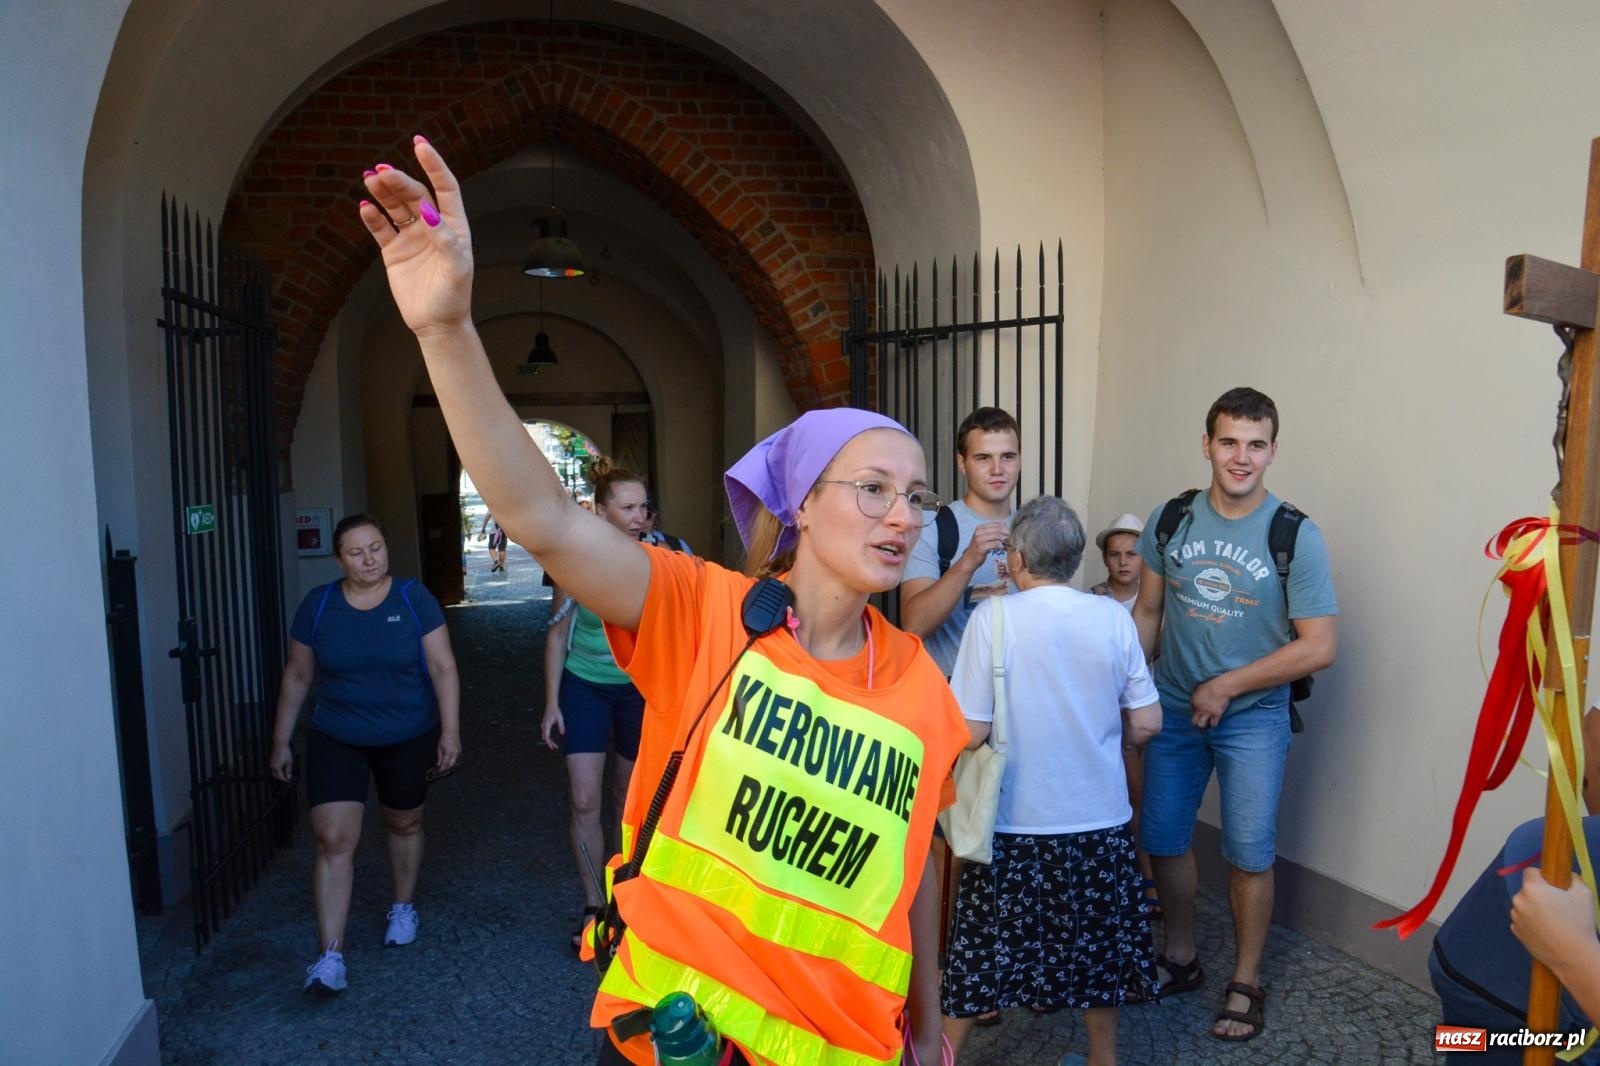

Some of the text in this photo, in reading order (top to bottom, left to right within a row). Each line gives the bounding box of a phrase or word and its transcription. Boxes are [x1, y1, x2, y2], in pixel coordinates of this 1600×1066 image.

[1214, 540, 1270, 581] TAILOR
[1176, 592, 1210, 610] PREMIUM
[1210, 604, 1244, 618] QUALITY
[722, 674, 920, 824] KIEROWANIE
[725, 774, 880, 889] RUCHEM
